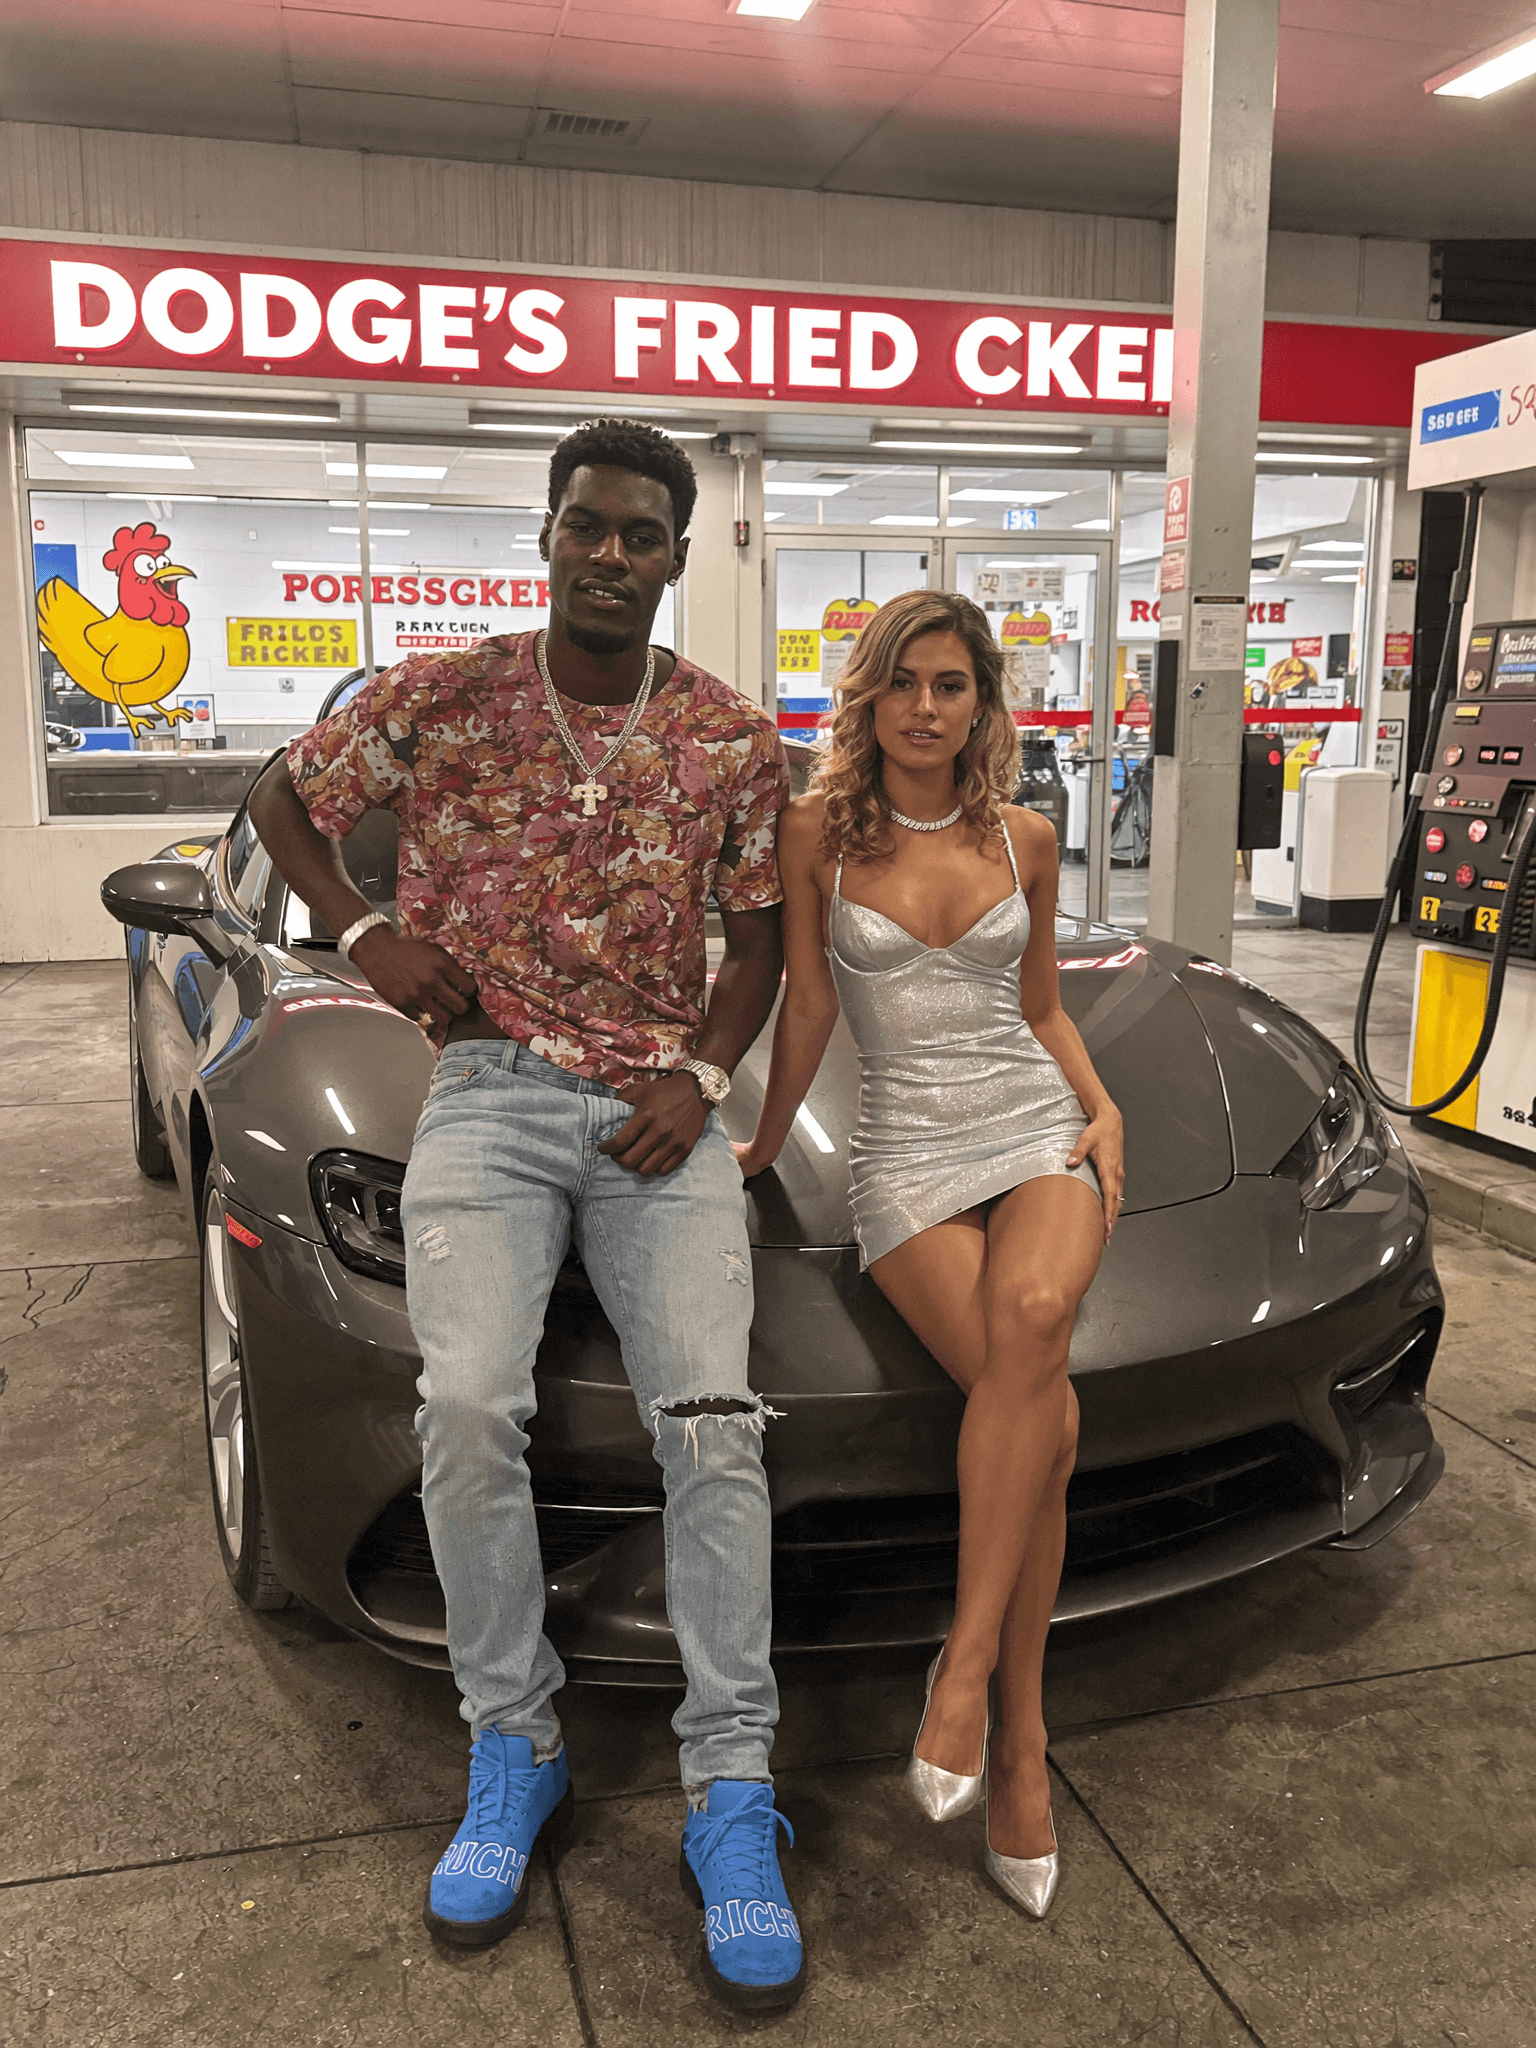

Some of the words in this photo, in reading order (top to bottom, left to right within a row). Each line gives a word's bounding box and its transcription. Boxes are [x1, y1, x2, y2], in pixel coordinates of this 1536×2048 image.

[50, 260, 568, 374] DODGE'S
[613, 296, 918, 391] FRIED
[954, 316, 1174, 402] CKE
[705, 1899, 801, 1953] RICH
